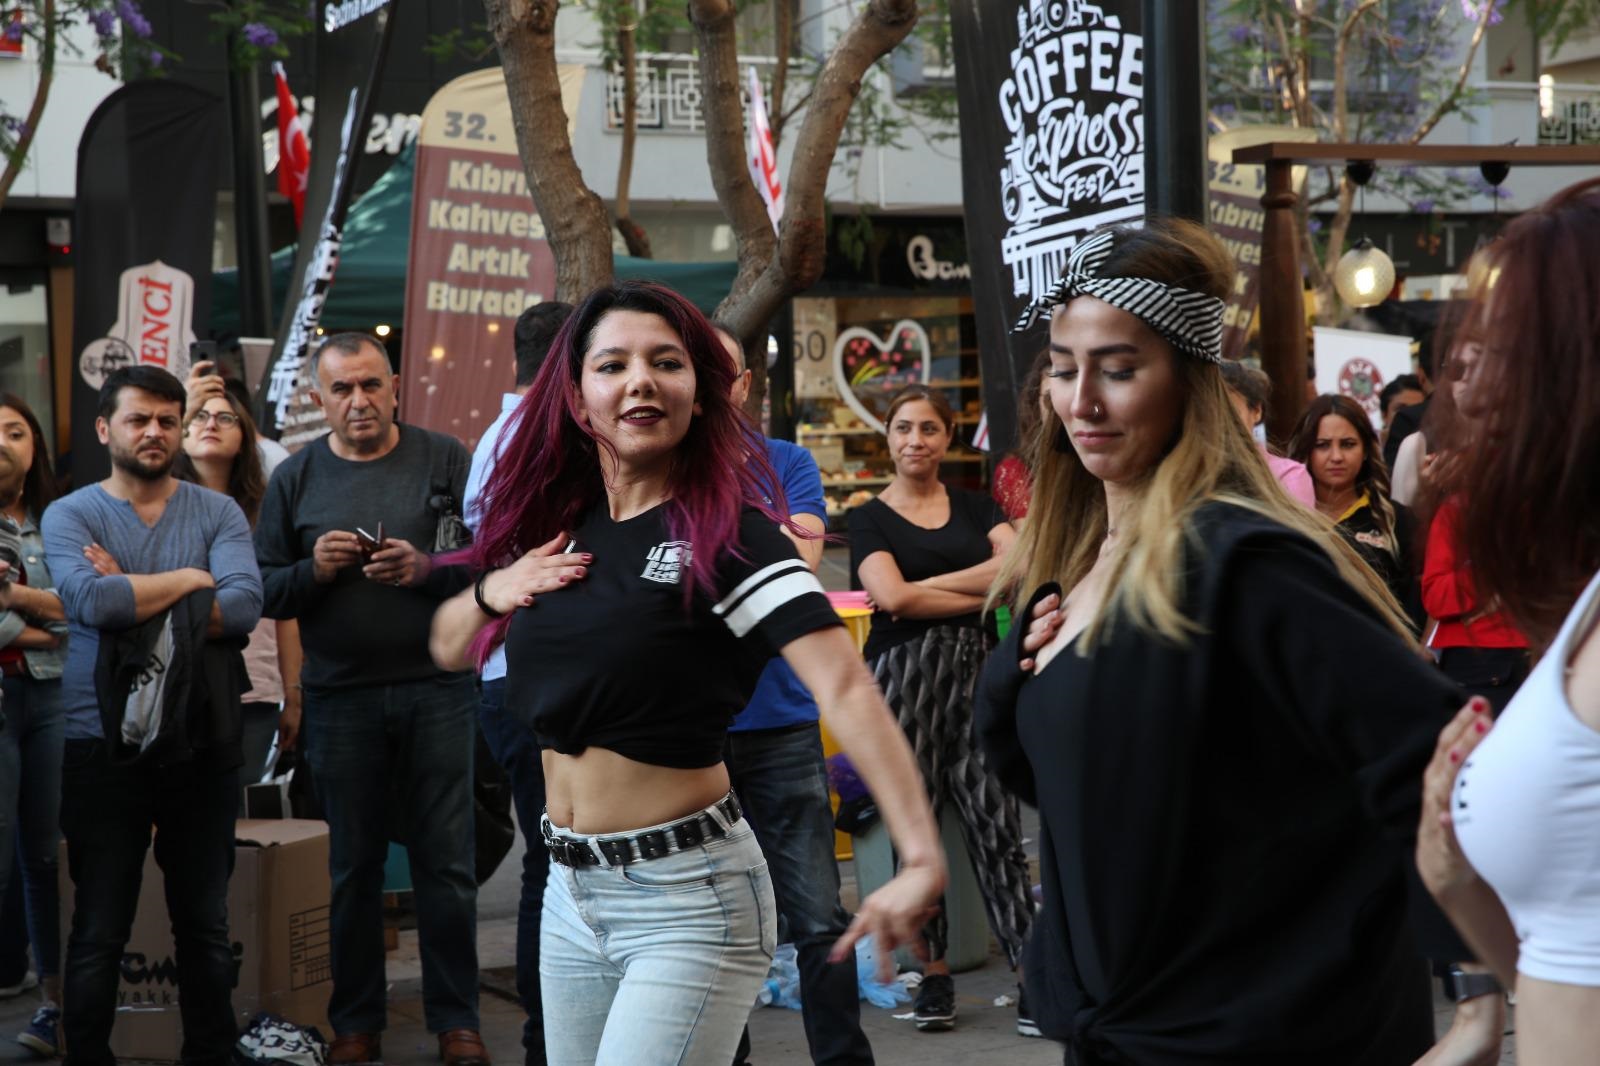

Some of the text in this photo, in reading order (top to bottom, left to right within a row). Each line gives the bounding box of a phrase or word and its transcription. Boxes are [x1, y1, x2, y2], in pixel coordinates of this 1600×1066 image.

[999, 30, 1143, 133] COFFEE
[443, 110, 496, 142] 32.
[448, 160, 534, 198] Kıbrı
[1062, 166, 1112, 208] FEST
[447, 242, 532, 278] Artık
